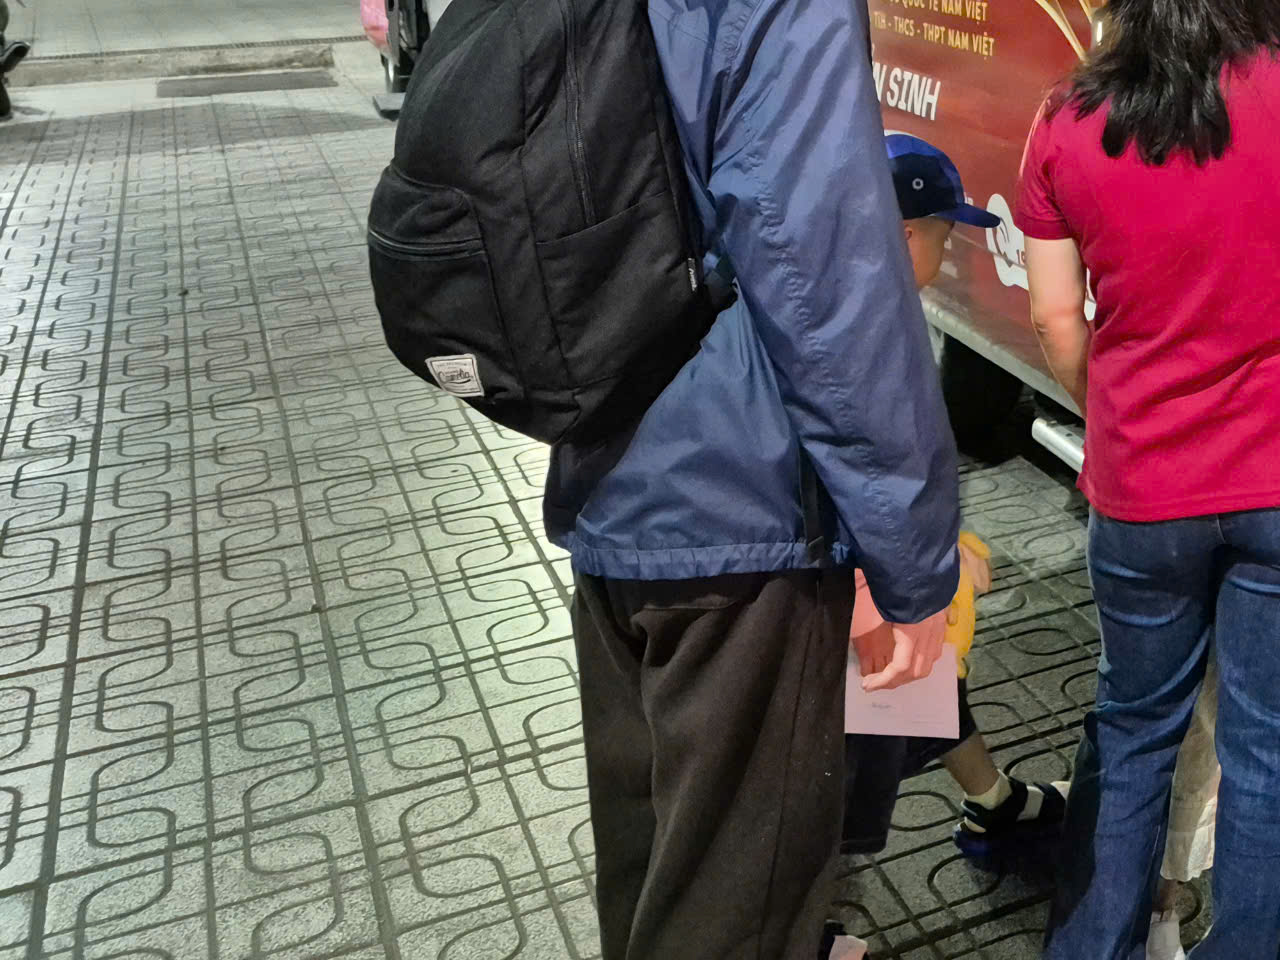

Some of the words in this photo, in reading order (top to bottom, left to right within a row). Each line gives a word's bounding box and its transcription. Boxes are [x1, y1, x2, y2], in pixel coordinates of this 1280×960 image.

[894, 16, 915, 37] THCS
[923, 22, 946, 44] THPT
[948, 29, 969, 50] NAM
[972, 31, 995, 60] VIỆT
[886, 67, 941, 120] SINH
